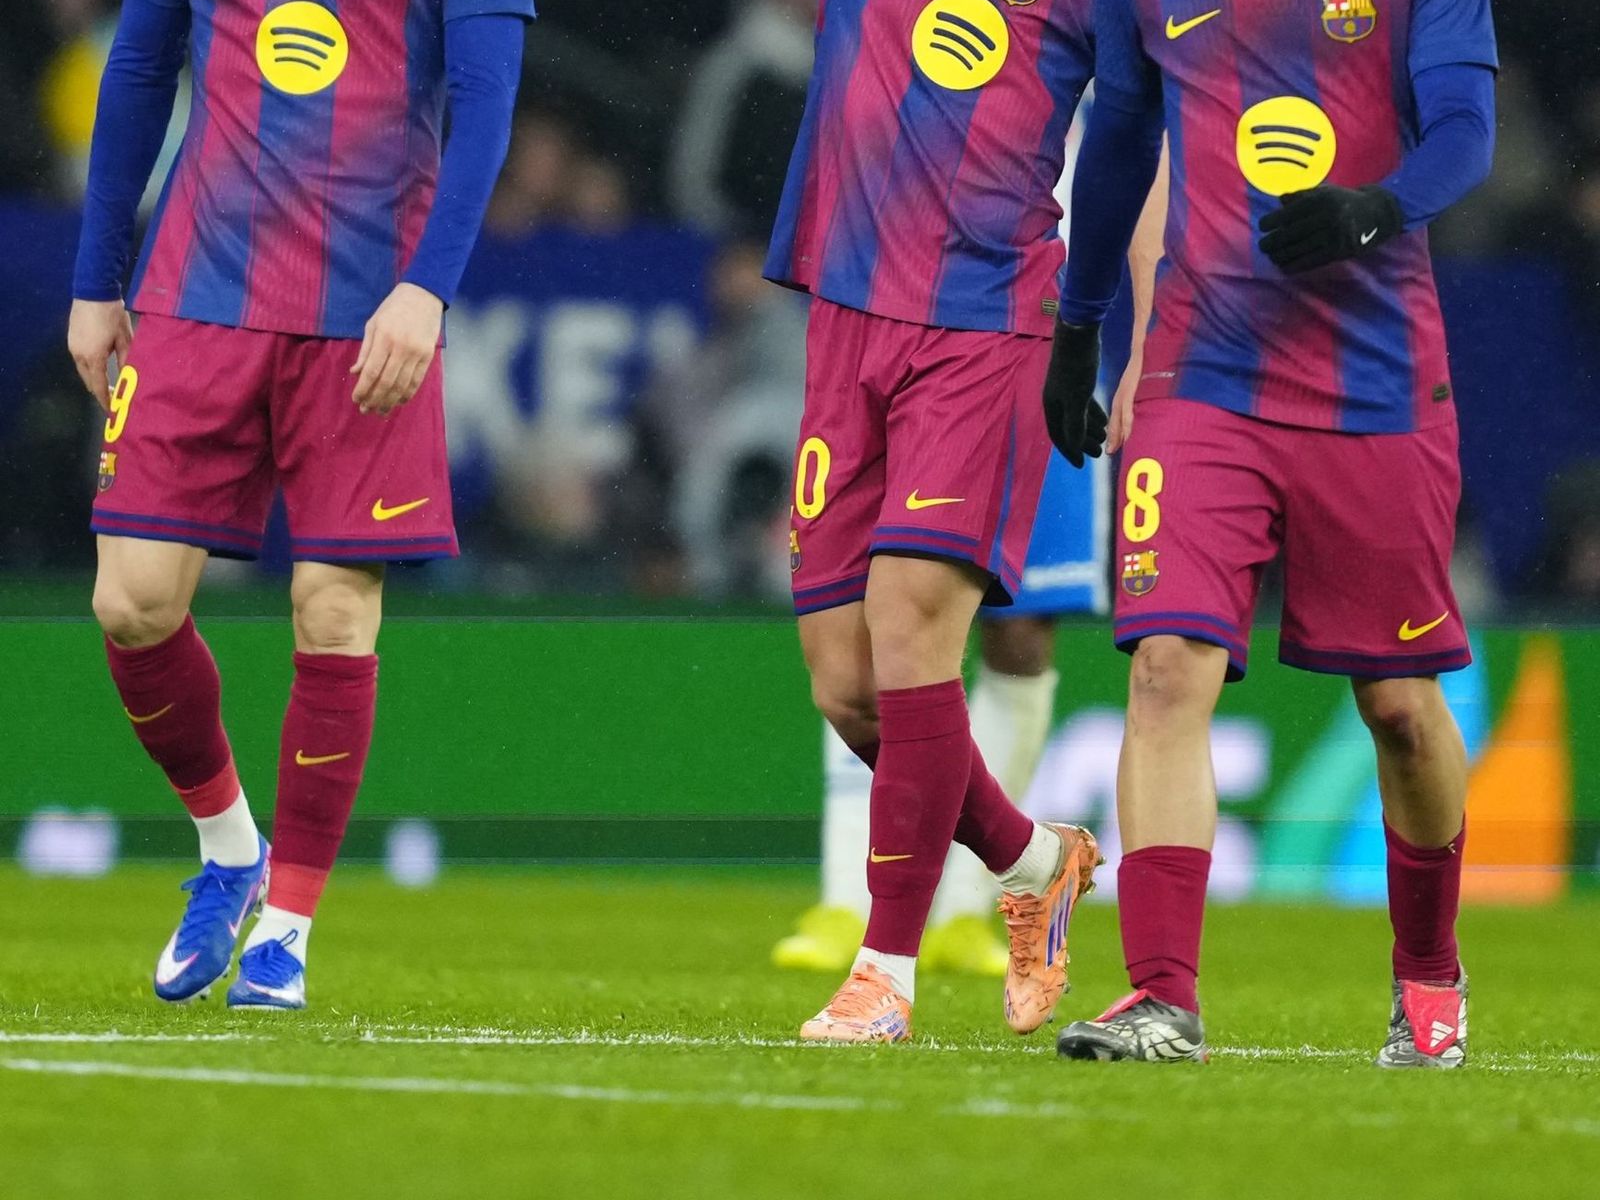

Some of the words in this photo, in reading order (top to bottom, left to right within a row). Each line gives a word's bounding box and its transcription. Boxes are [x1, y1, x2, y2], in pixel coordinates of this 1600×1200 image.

[104, 364, 138, 443] 9
[791, 436, 830, 519] 0
[1122, 457, 1163, 543] 8
